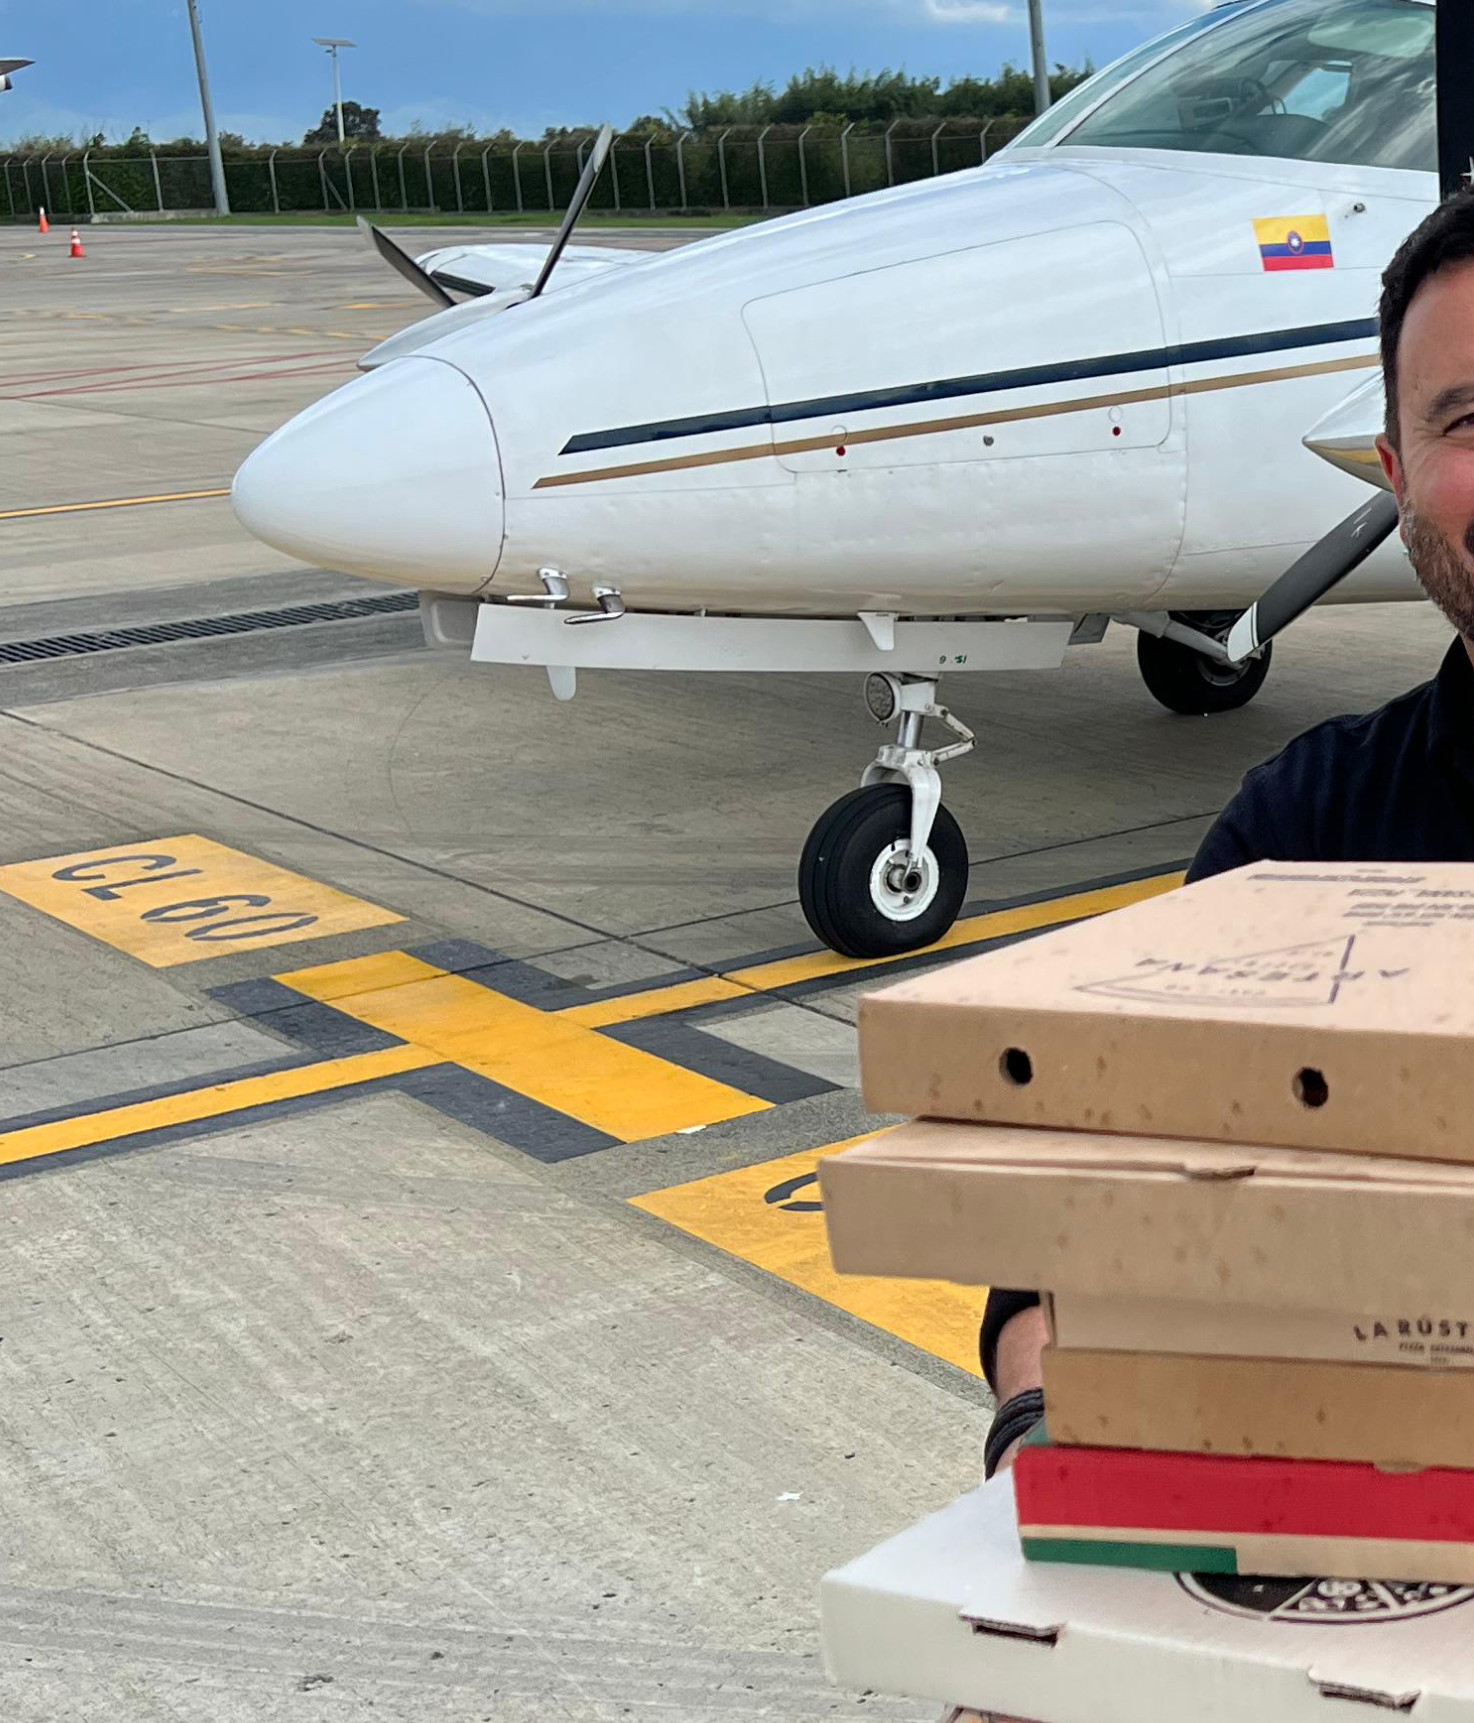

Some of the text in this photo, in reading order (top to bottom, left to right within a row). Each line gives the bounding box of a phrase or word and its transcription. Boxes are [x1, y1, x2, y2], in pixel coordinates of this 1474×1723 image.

[51, 854, 319, 941] CL 60
[1353, 1320, 1388, 1341] LA
